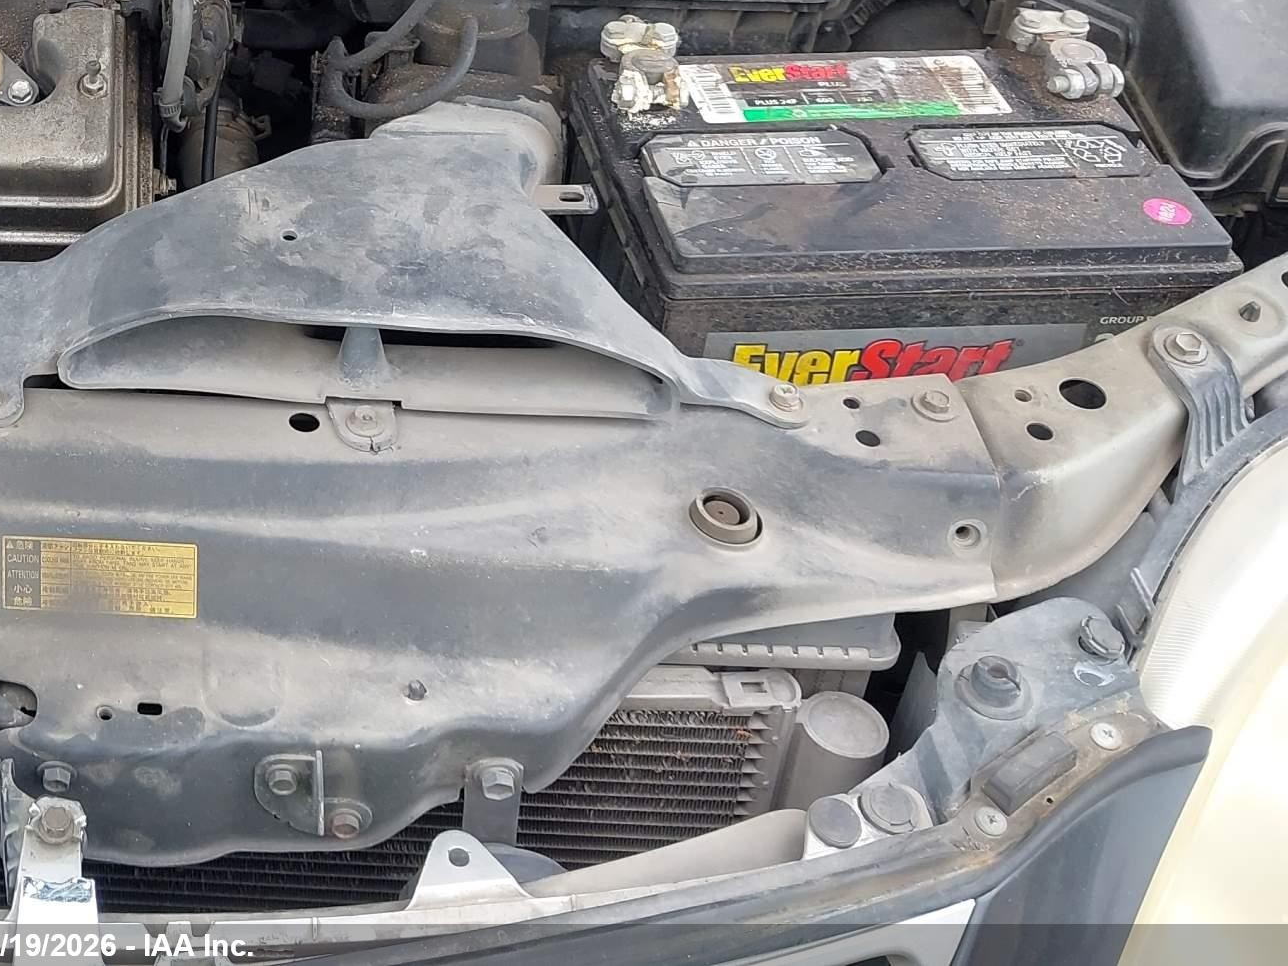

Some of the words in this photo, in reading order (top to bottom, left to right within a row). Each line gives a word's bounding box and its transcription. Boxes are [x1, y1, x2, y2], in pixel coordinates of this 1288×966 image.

[701, 138, 758, 147] DANGER
[770, 136, 822, 146] POISON
[1100, 316, 1145, 325] GROUP
[7, 553, 39, 563] CAUTION
[7, 569, 39, 579] ATTENTION
